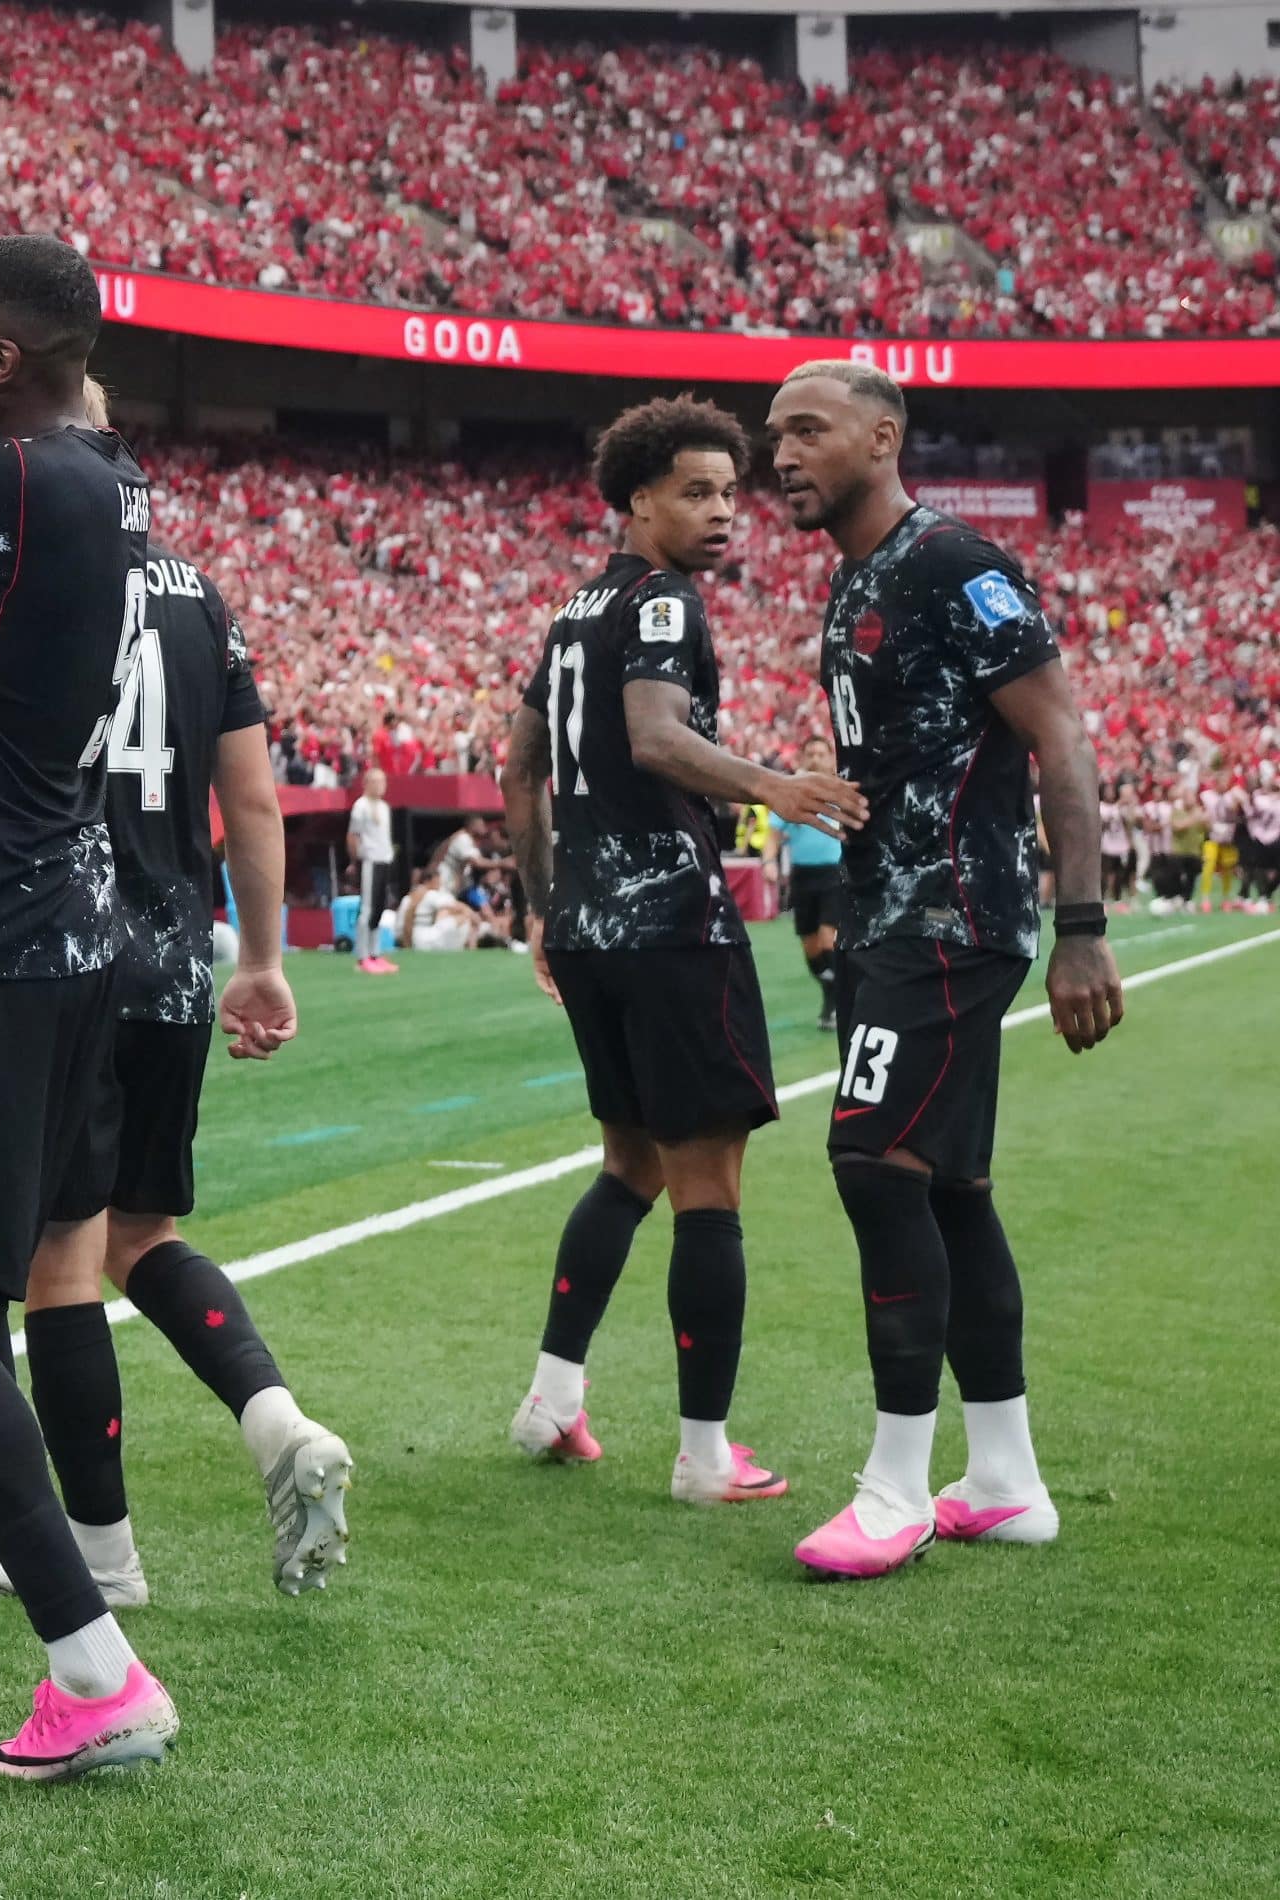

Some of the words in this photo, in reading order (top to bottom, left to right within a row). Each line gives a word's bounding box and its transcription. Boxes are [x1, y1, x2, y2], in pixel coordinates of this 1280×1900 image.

[403, 316, 521, 364] GOOA
[146, 559, 205, 599] OLLES
[107, 628, 175, 812] 4
[832, 674, 863, 747] 13
[840, 1023, 899, 1104] 13
